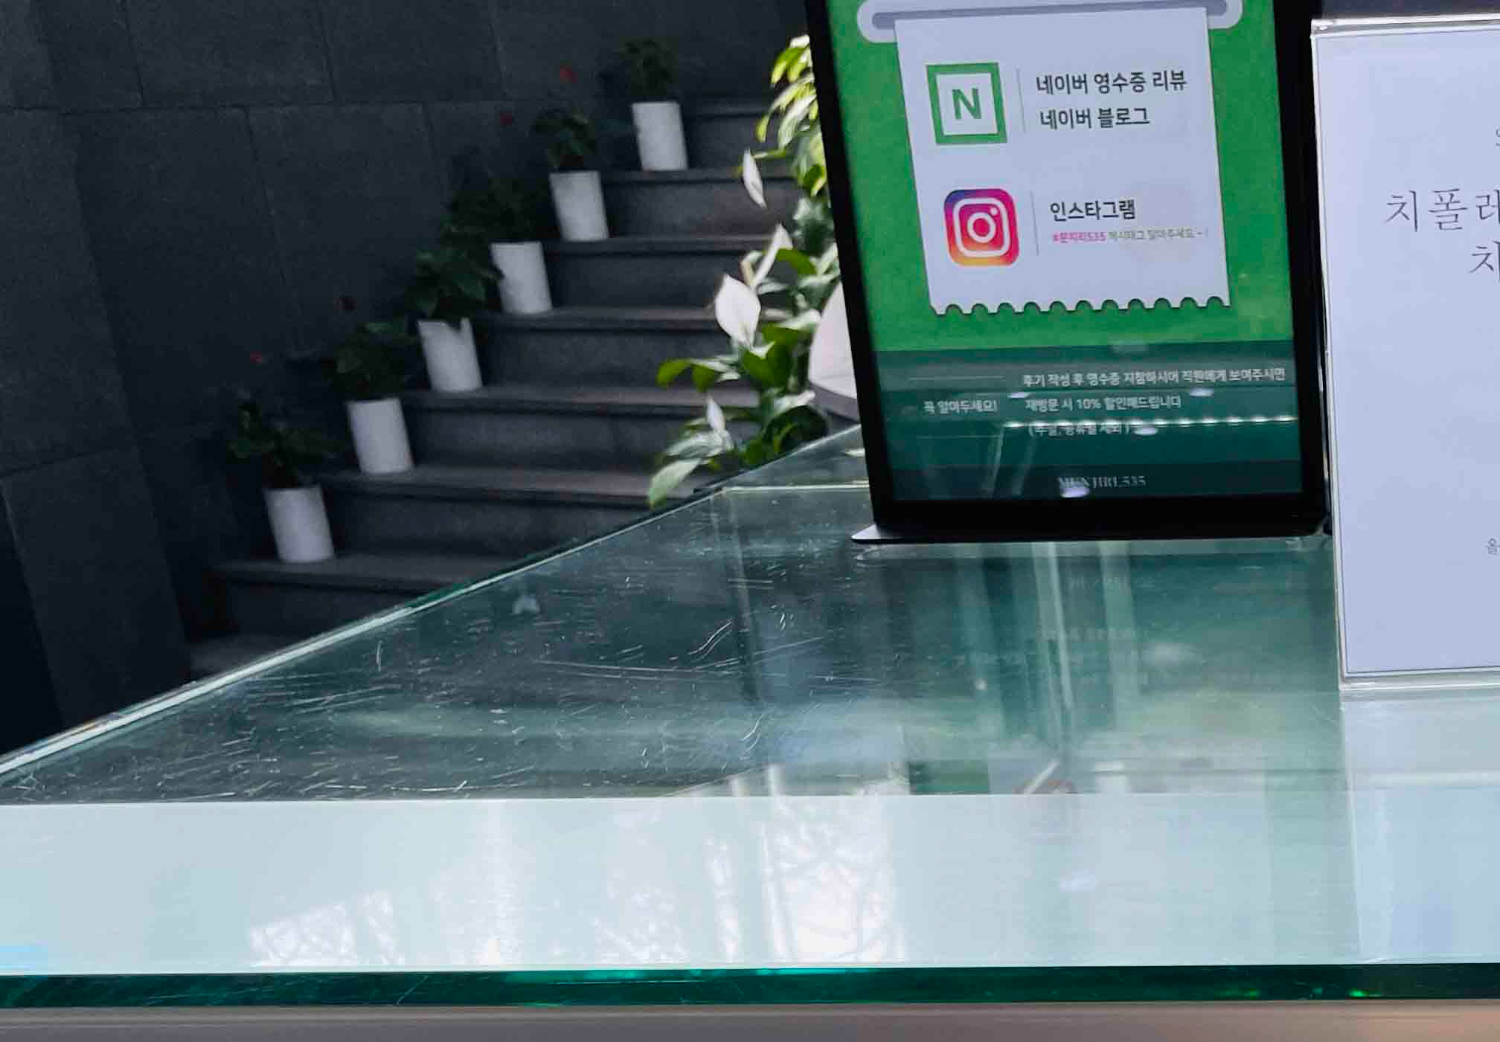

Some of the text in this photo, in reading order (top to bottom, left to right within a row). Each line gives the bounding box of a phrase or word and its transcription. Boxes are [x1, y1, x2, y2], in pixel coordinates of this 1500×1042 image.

[1036, 69, 1187, 95] 네이버 영수증 리뷰
[952, 88, 983, 120] N
[1040, 106, 1150, 130] 네이버 블로그
[1050, 199, 1136, 222] 인스타그램
[1023, 374, 1046, 388] 후기
[1048, 373, 1071, 387] 작성
[1072, 373, 1085, 386] 후
[1086, 371, 1120, 386] 영수증
[1061, 398, 1074, 411] 시
[1076, 397, 1102, 411] 10%
